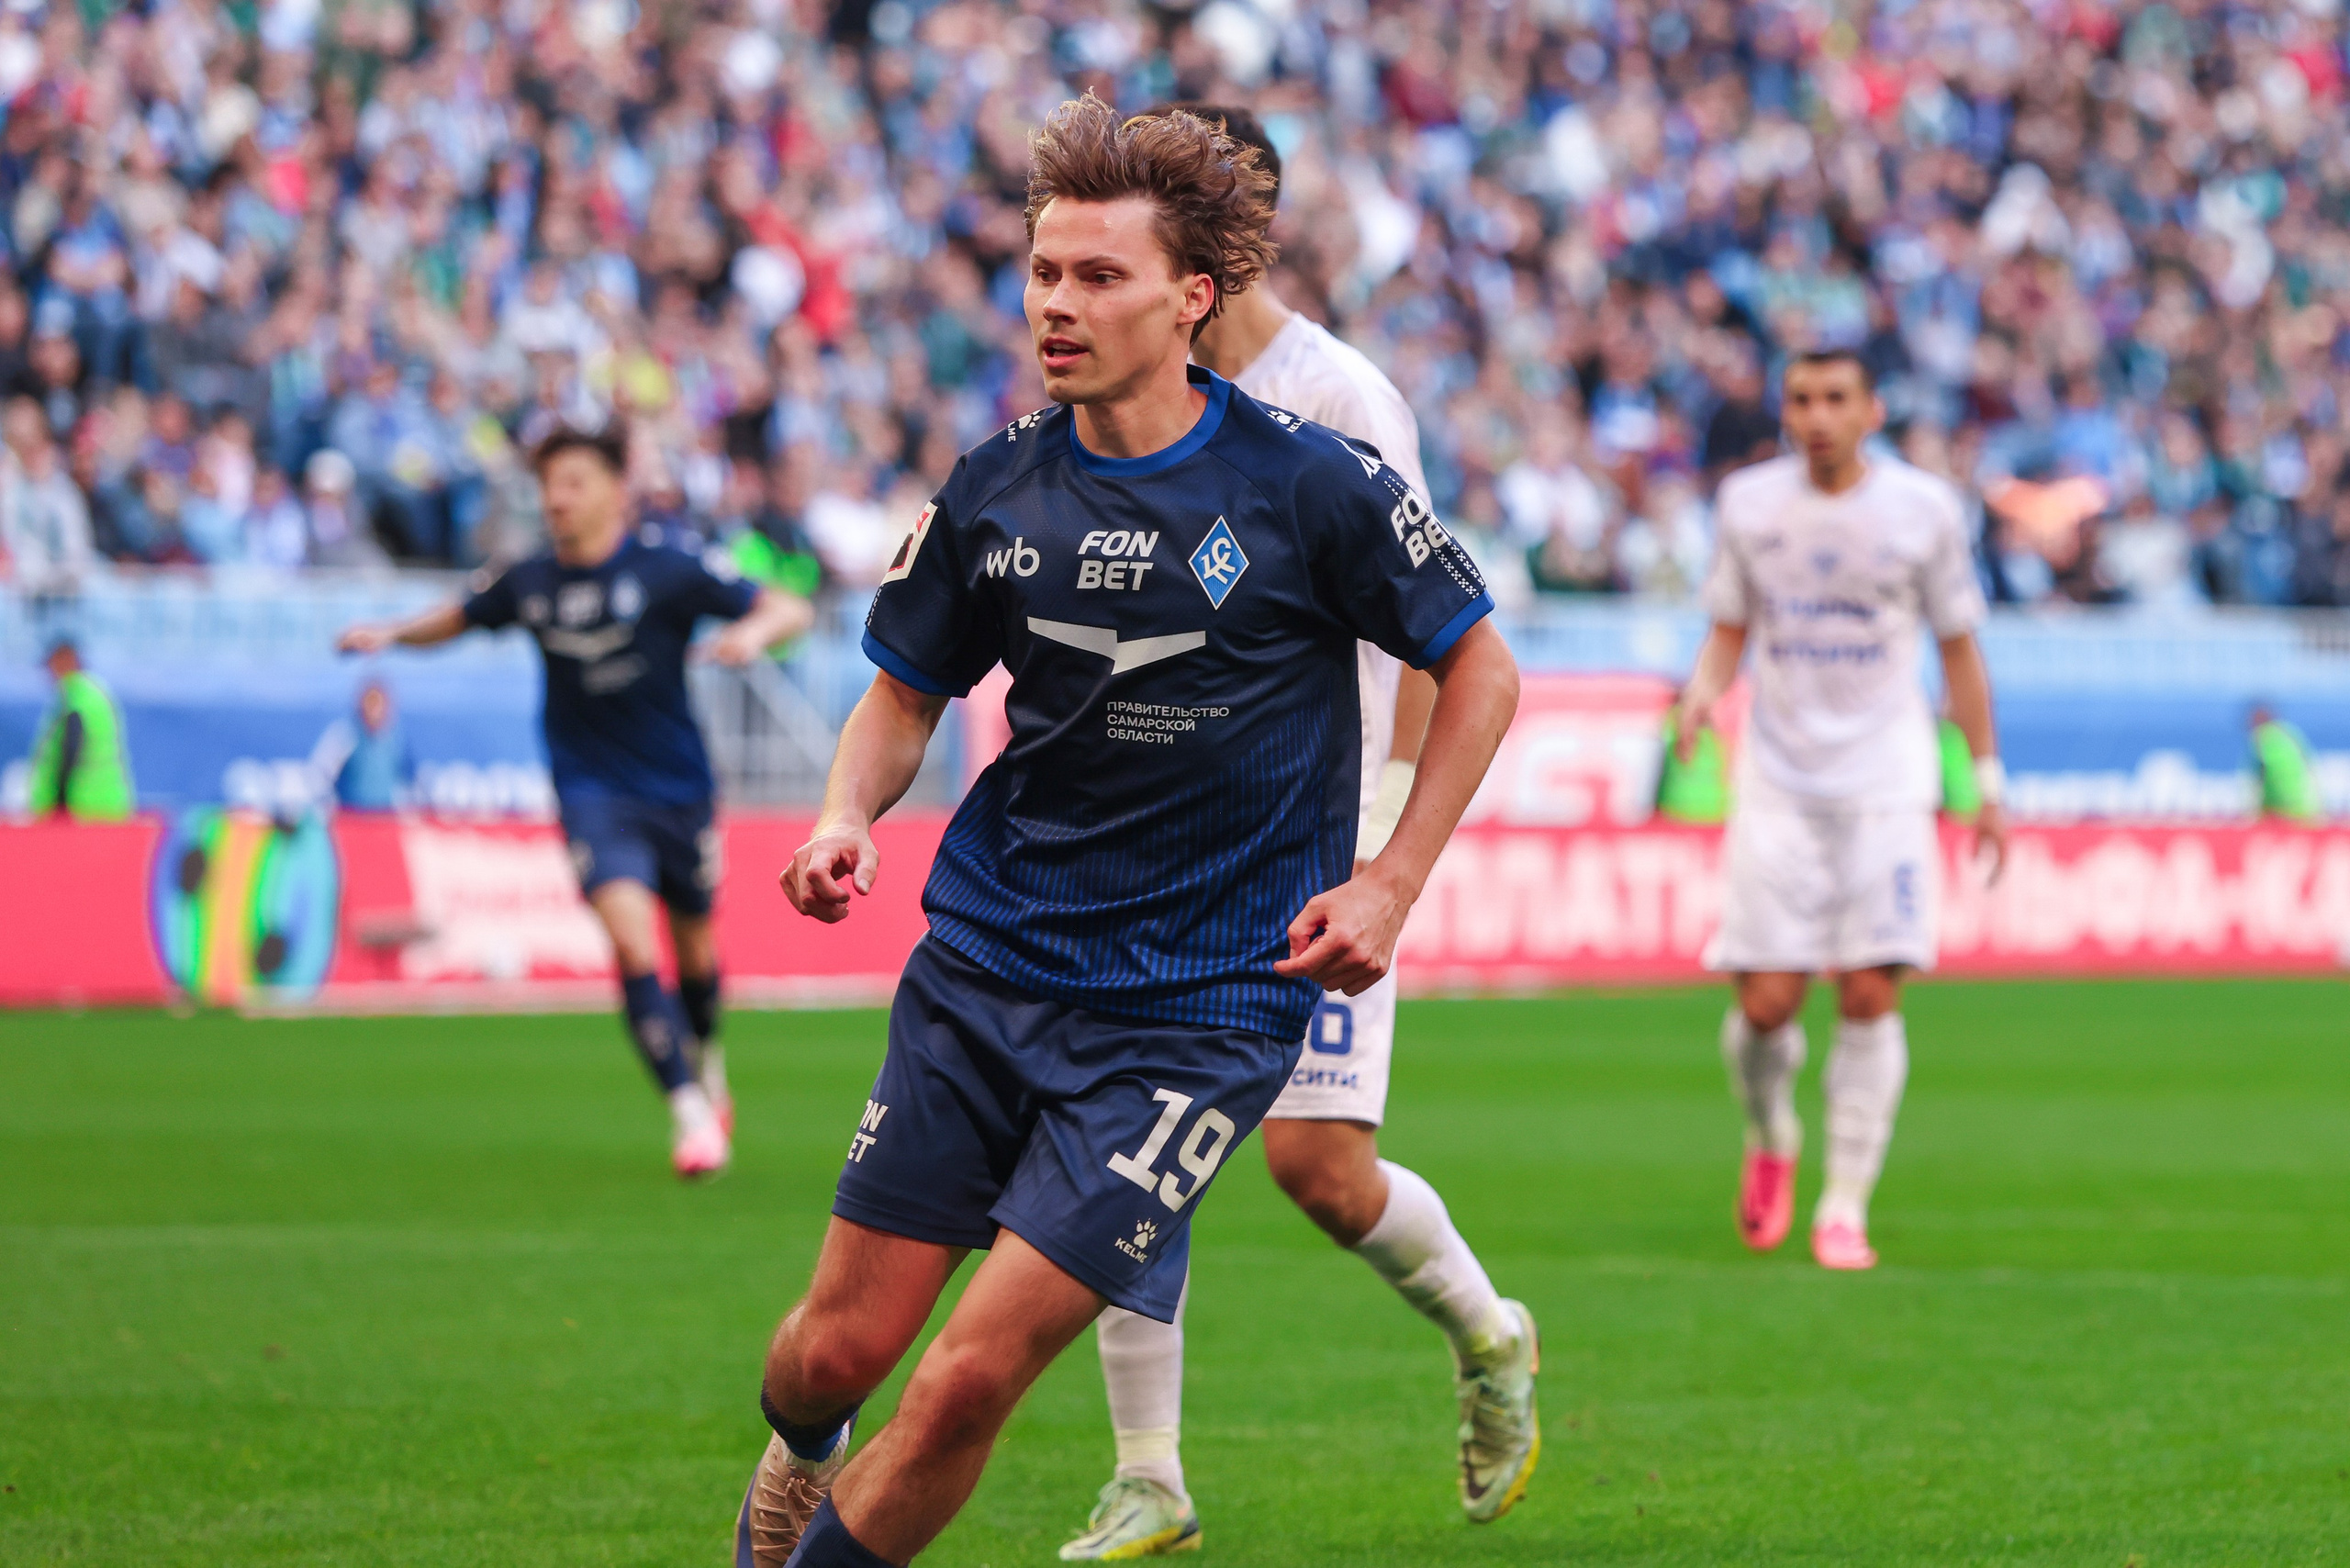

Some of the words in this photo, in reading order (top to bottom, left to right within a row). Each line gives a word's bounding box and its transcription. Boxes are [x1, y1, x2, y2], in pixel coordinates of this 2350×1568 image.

[1008, 421, 1016, 442] LME
[1391, 488, 1431, 543] FO
[1077, 531, 1159, 557] FON
[1405, 513, 1452, 569] BE
[986, 536, 1041, 578] wb
[1076, 559, 1154, 591] BET
[1107, 701, 1230, 718] ПРАВИТЕЛЬСТВО
[1107, 714, 1195, 732] САМАРСКОЙ
[1107, 728, 1174, 745] ОБЛАСТИ
[1106, 1087, 1236, 1213] 19
[1114, 1237, 1147, 1263] KELME
